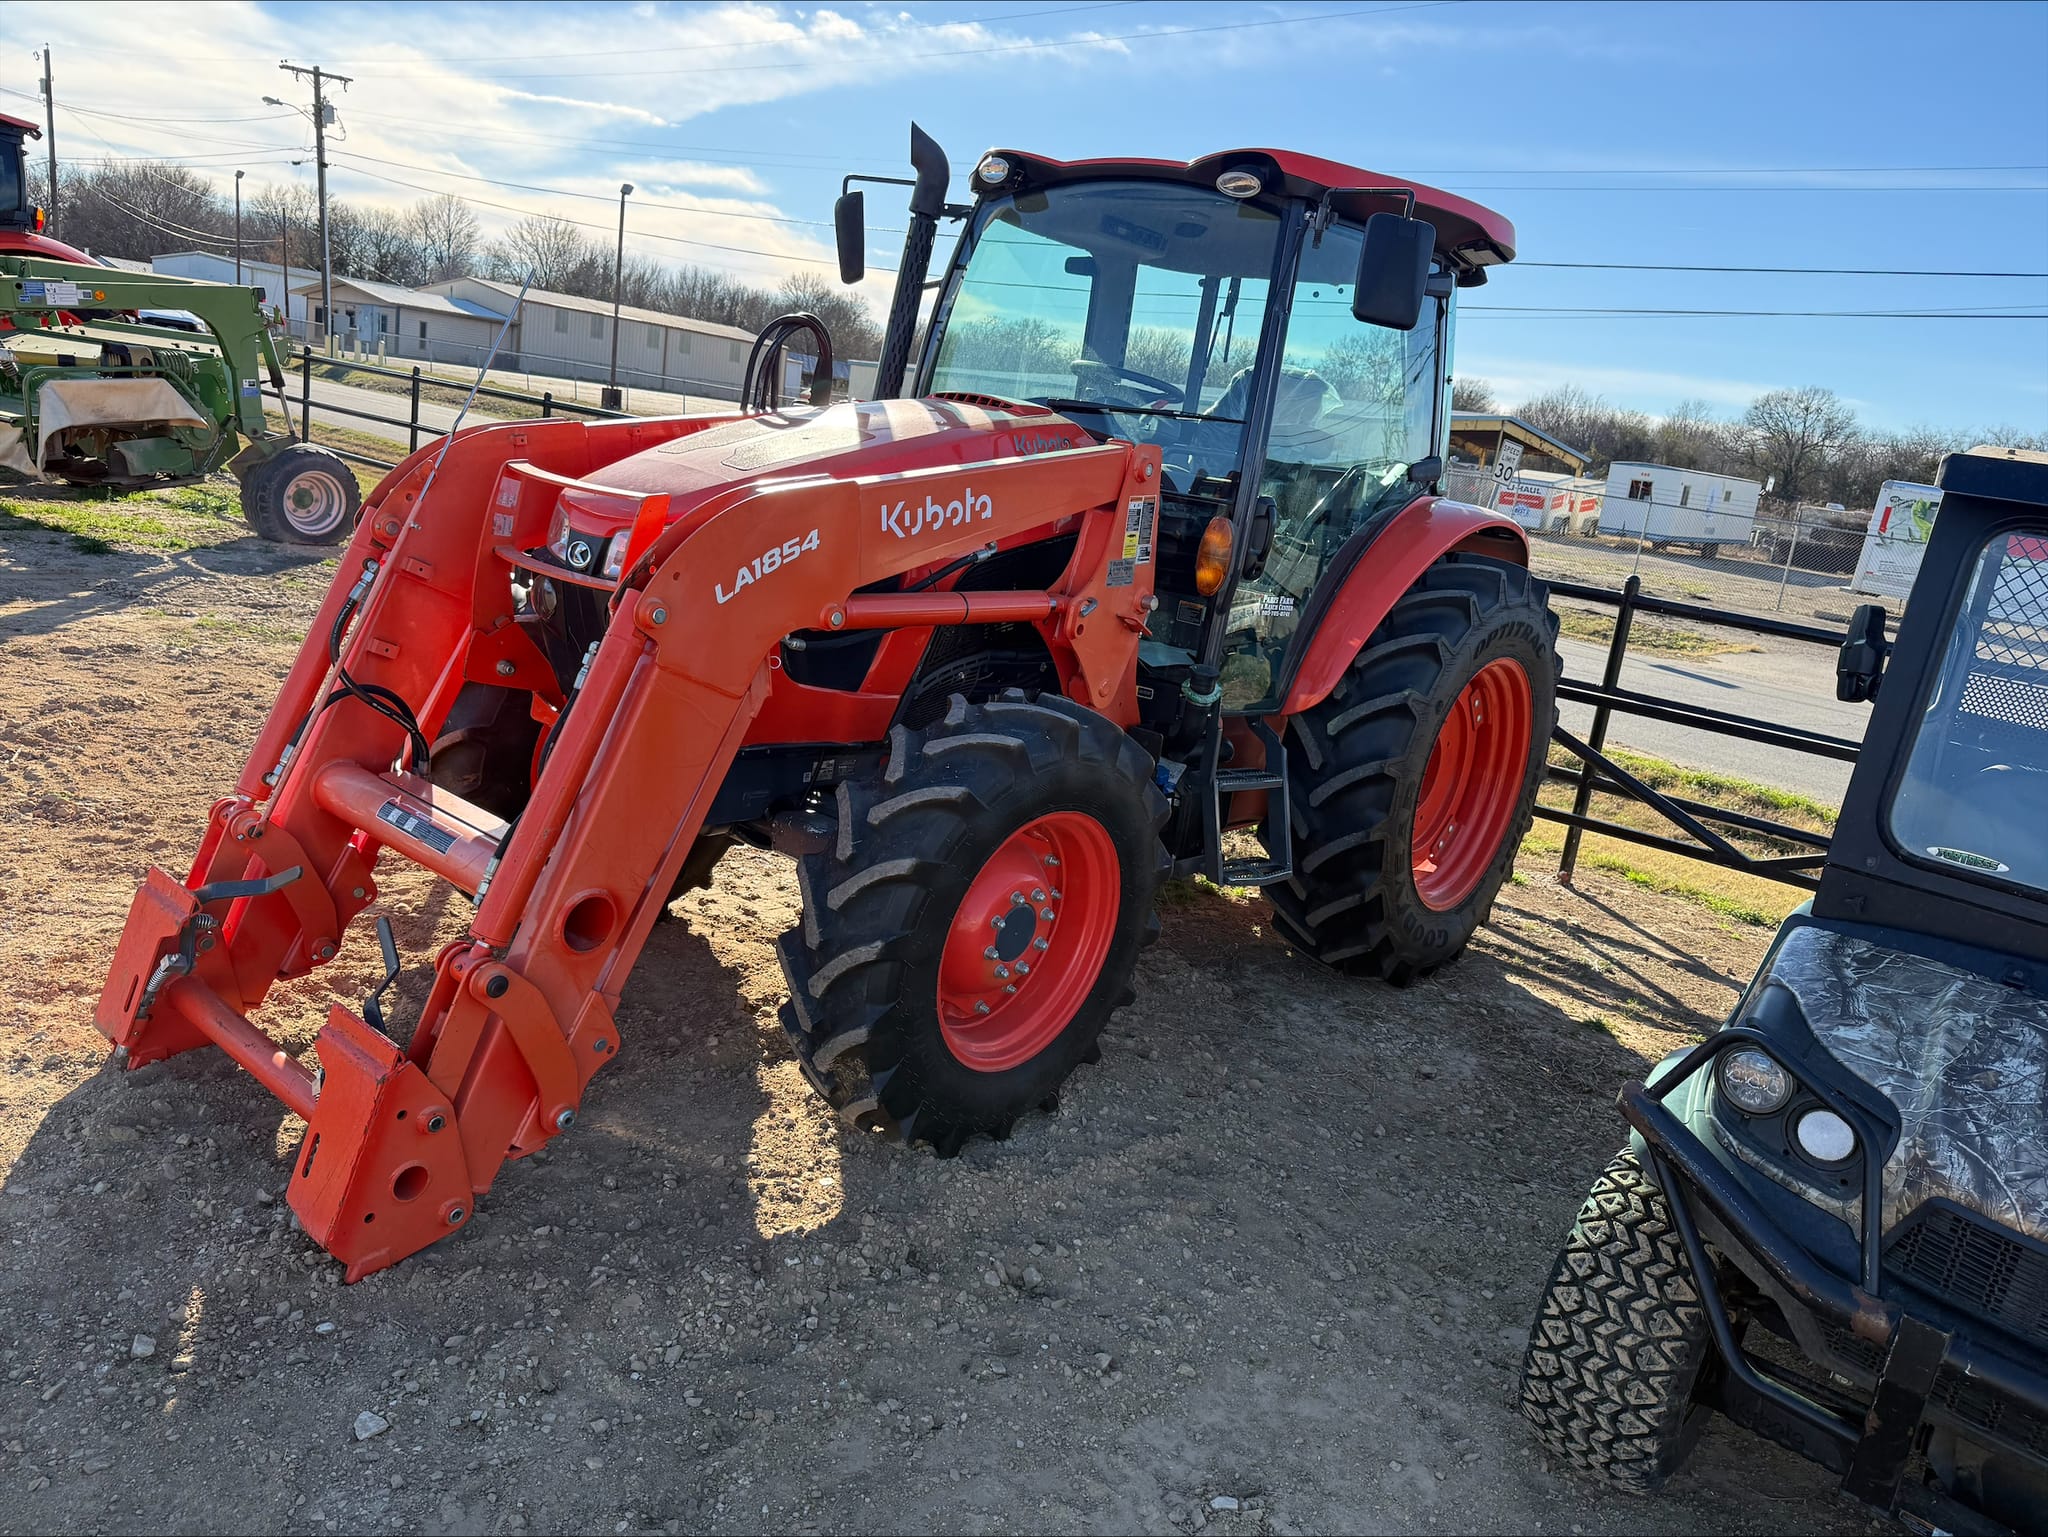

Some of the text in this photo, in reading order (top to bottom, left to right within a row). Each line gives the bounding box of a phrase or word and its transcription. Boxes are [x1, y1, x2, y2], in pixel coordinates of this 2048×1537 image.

[1013, 433, 1072, 456] Kubota
[1503, 445, 1520, 457] SPEED
[1502, 455, 1516, 464] LIMIT
[1494, 463, 1513, 481] 30
[881, 488, 993, 538] Kubota
[715, 529, 820, 604] LA1854
[1473, 621, 1546, 660] OPTITRAC
